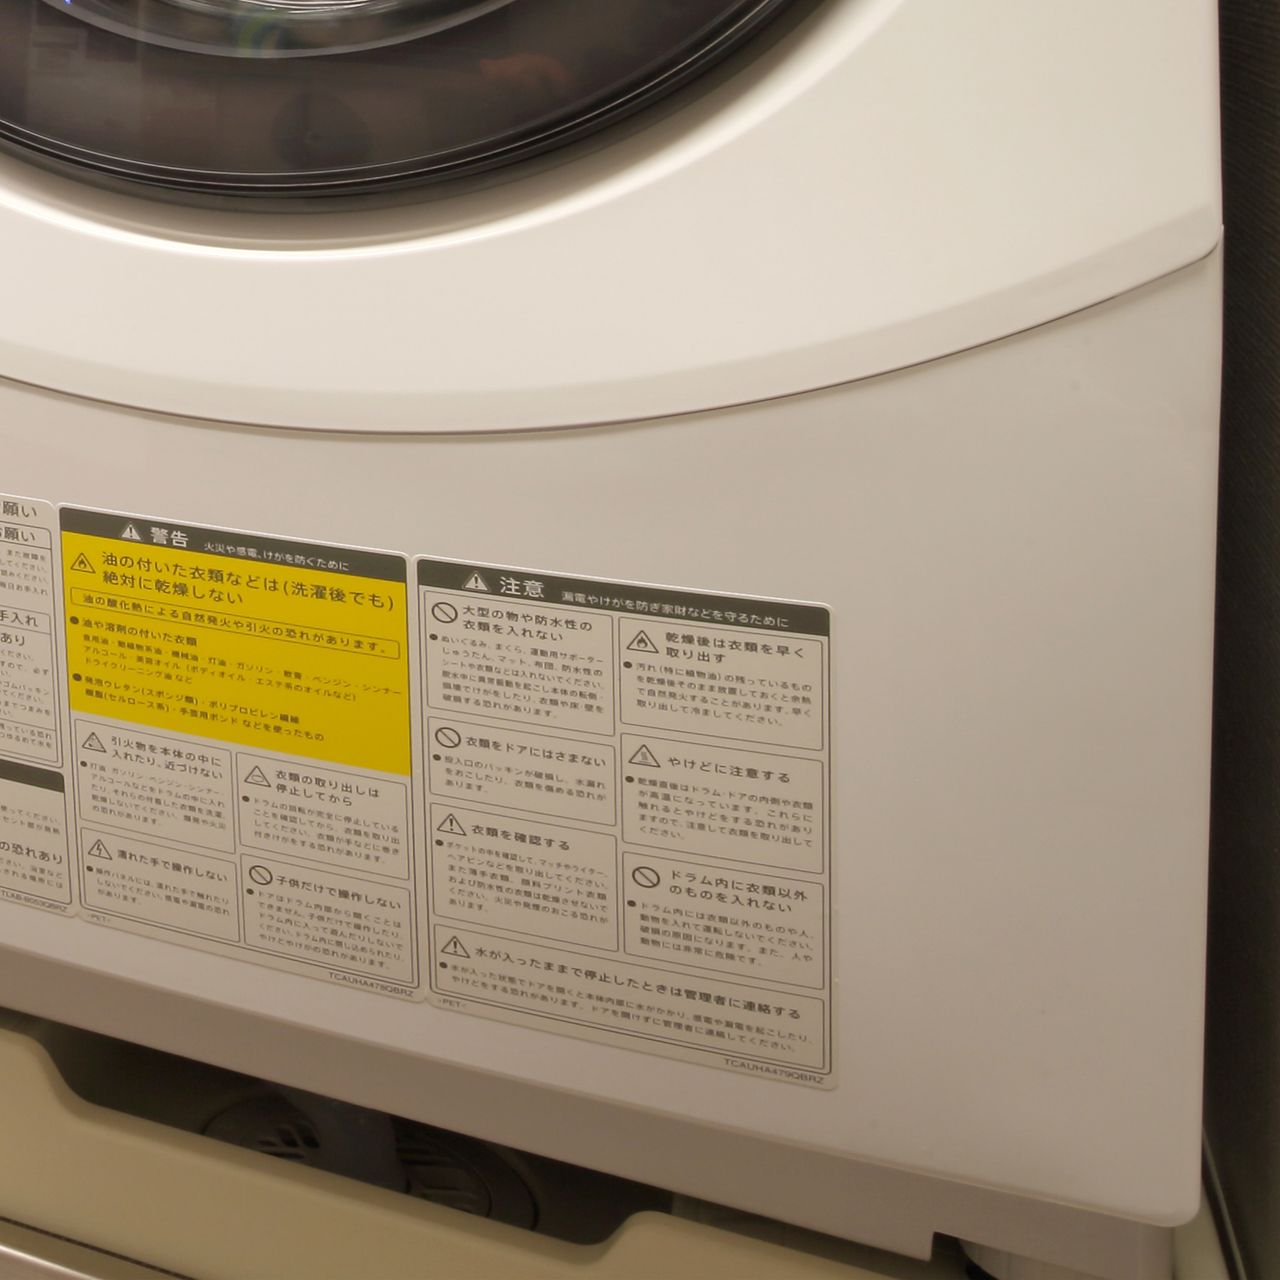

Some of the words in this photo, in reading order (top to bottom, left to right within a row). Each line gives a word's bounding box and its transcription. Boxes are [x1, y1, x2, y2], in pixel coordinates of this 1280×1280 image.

[150, 526, 189, 548] 警告
[203, 541, 350, 571] 火災や感電、けがを防ぐために
[101, 551, 394, 611] 油の付いた衣類などは(洗濯後でも)
[102, 570, 243, 605] 絶対に乾燥しない
[462, 604, 592, 632] 大型の物や防水性の
[499, 576, 545, 599] 注意
[561, 589, 789, 629] 漏電やけがを防ぎ家財などを守るために
[82, 593, 387, 655] 油の酸化熱による自然発火や引火の恐れがあります。
[82, 617, 198, 646] 油や溶剤の付いた衣類
[463, 620, 563, 642] 衣類を入れない
[665, 632, 804, 658] 乾燥後は衣類を早く
[666, 647, 726, 664] 取り出す
[111, 735, 222, 767] 引火物を本体の中に
[112, 749, 223, 780] 入れたり、近づけない
[466, 736, 606, 767] 衣類をドアにはさまない
[276, 769, 379, 798] 衣類の取り出しは
[667, 757, 791, 784] やけどに注意する
[276, 783, 353, 806] 停止してから
[471, 825, 570, 851] 衣類を確認する
[117, 849, 228, 882] 濡れた手で操作しない
[276, 875, 401, 909] 子供だけで操作しない
[669, 885, 792, 912] のものを入れない
[672, 870, 808, 902] ドラム内に衣類以外
[475, 946, 801, 1021] 水が入ったままで停止したときは管理者に連絡する
